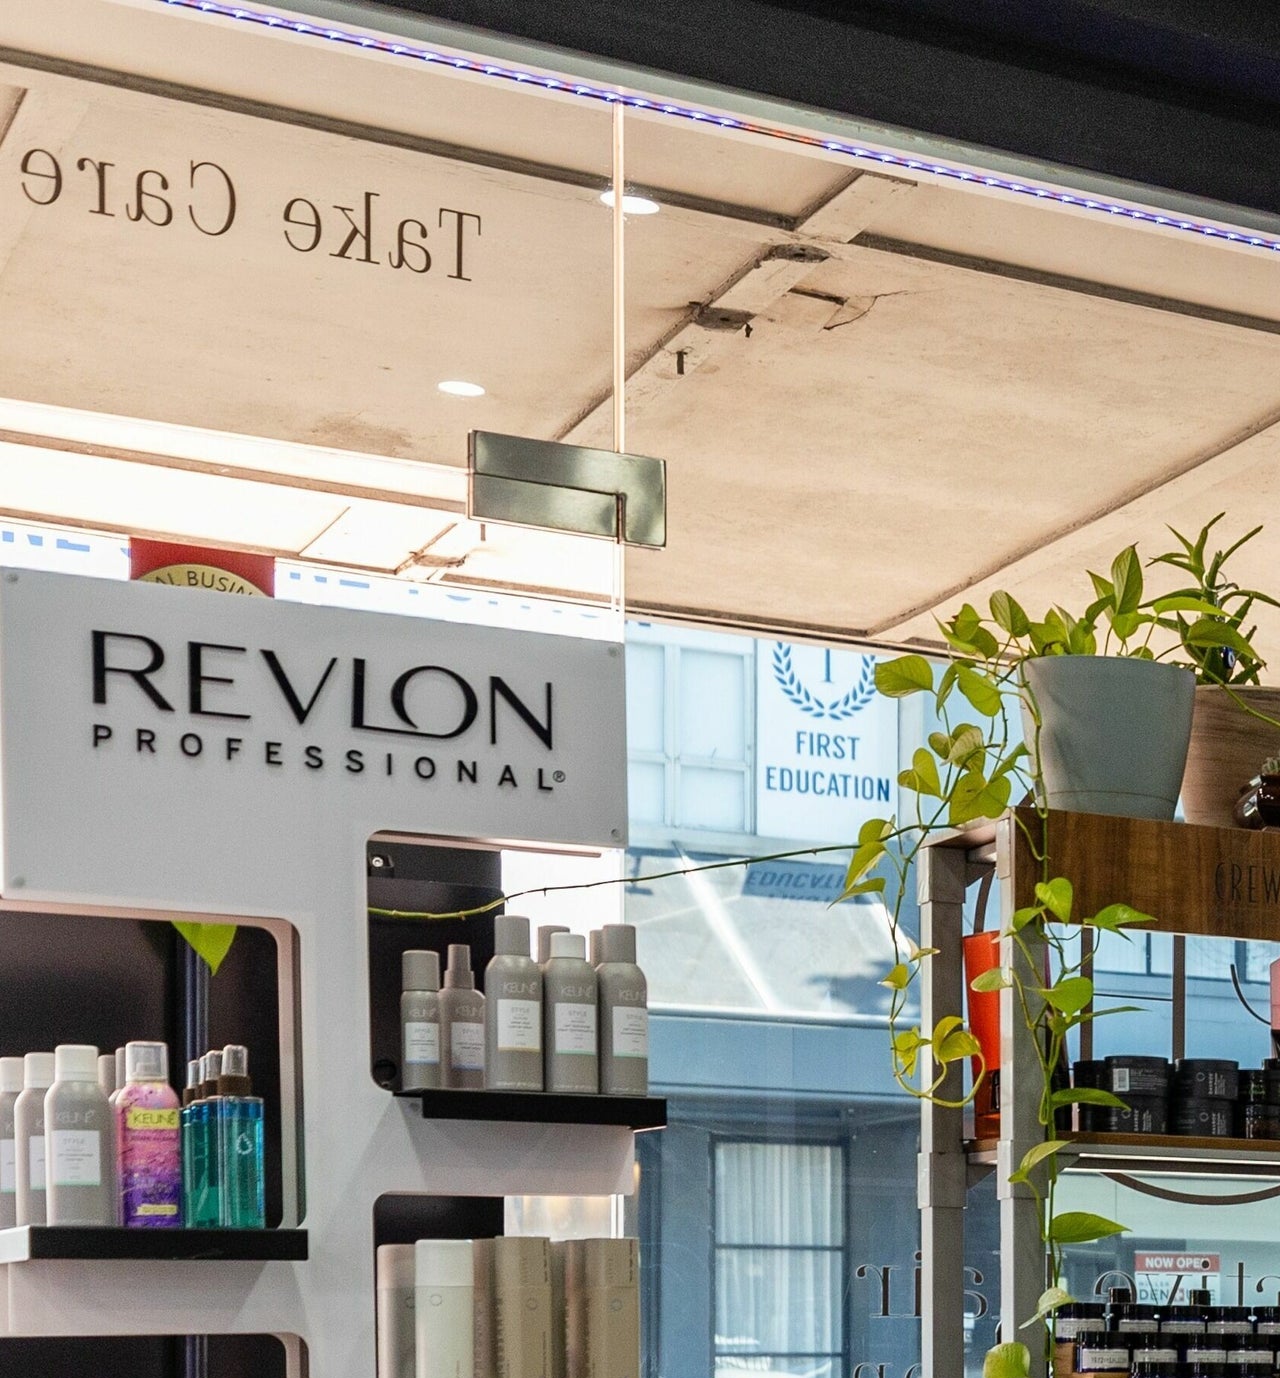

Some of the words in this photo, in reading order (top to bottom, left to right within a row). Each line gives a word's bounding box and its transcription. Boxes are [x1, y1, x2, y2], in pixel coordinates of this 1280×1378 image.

[91, 629, 554, 751] REVLON
[796, 731, 861, 762] FIRST
[766, 766, 891, 802] EDUCATION
[133, 1111, 176, 1125] KEUNE
[1145, 1256, 1174, 1269] NOW
